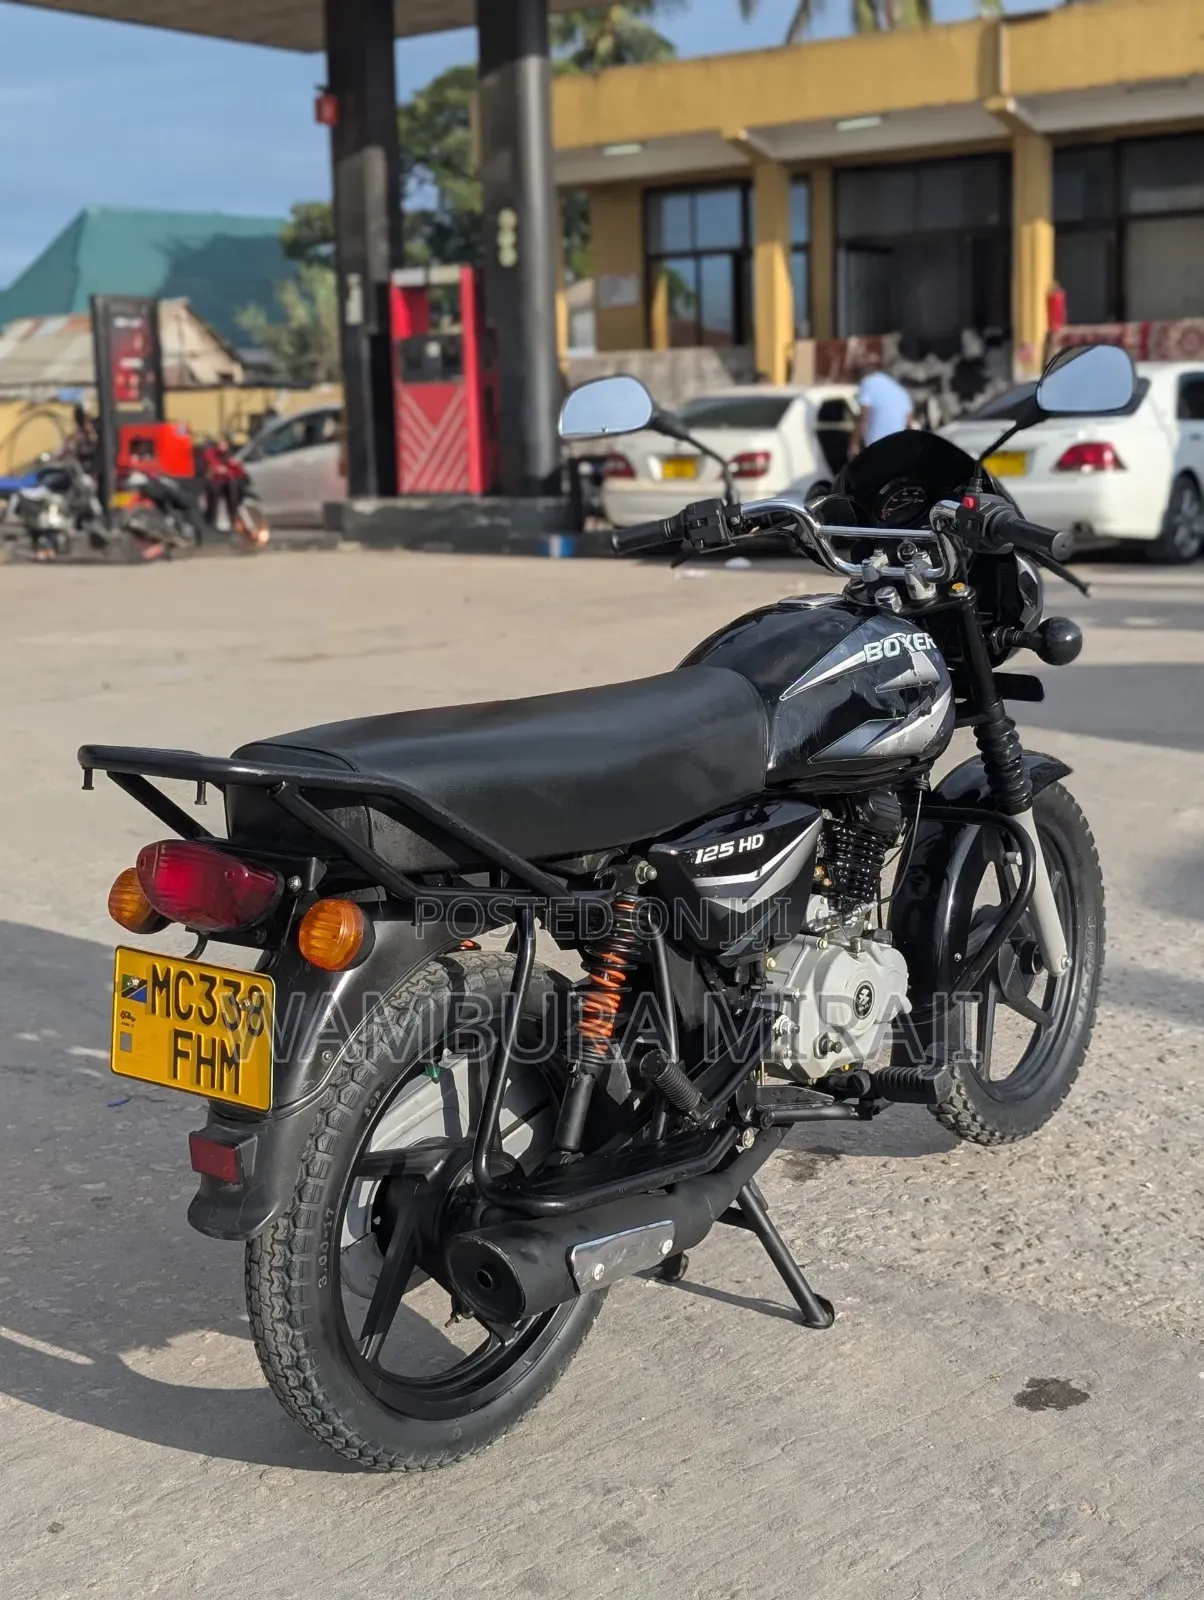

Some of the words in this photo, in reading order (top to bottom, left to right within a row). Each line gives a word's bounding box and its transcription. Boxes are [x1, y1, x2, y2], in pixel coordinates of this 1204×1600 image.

[864, 633, 937, 662] BOXER
[694, 840, 734, 864] 125
[738, 834, 765, 853] HD
[151, 963, 265, 1037] MC338
[172, 1028, 241, 1095] FHM
